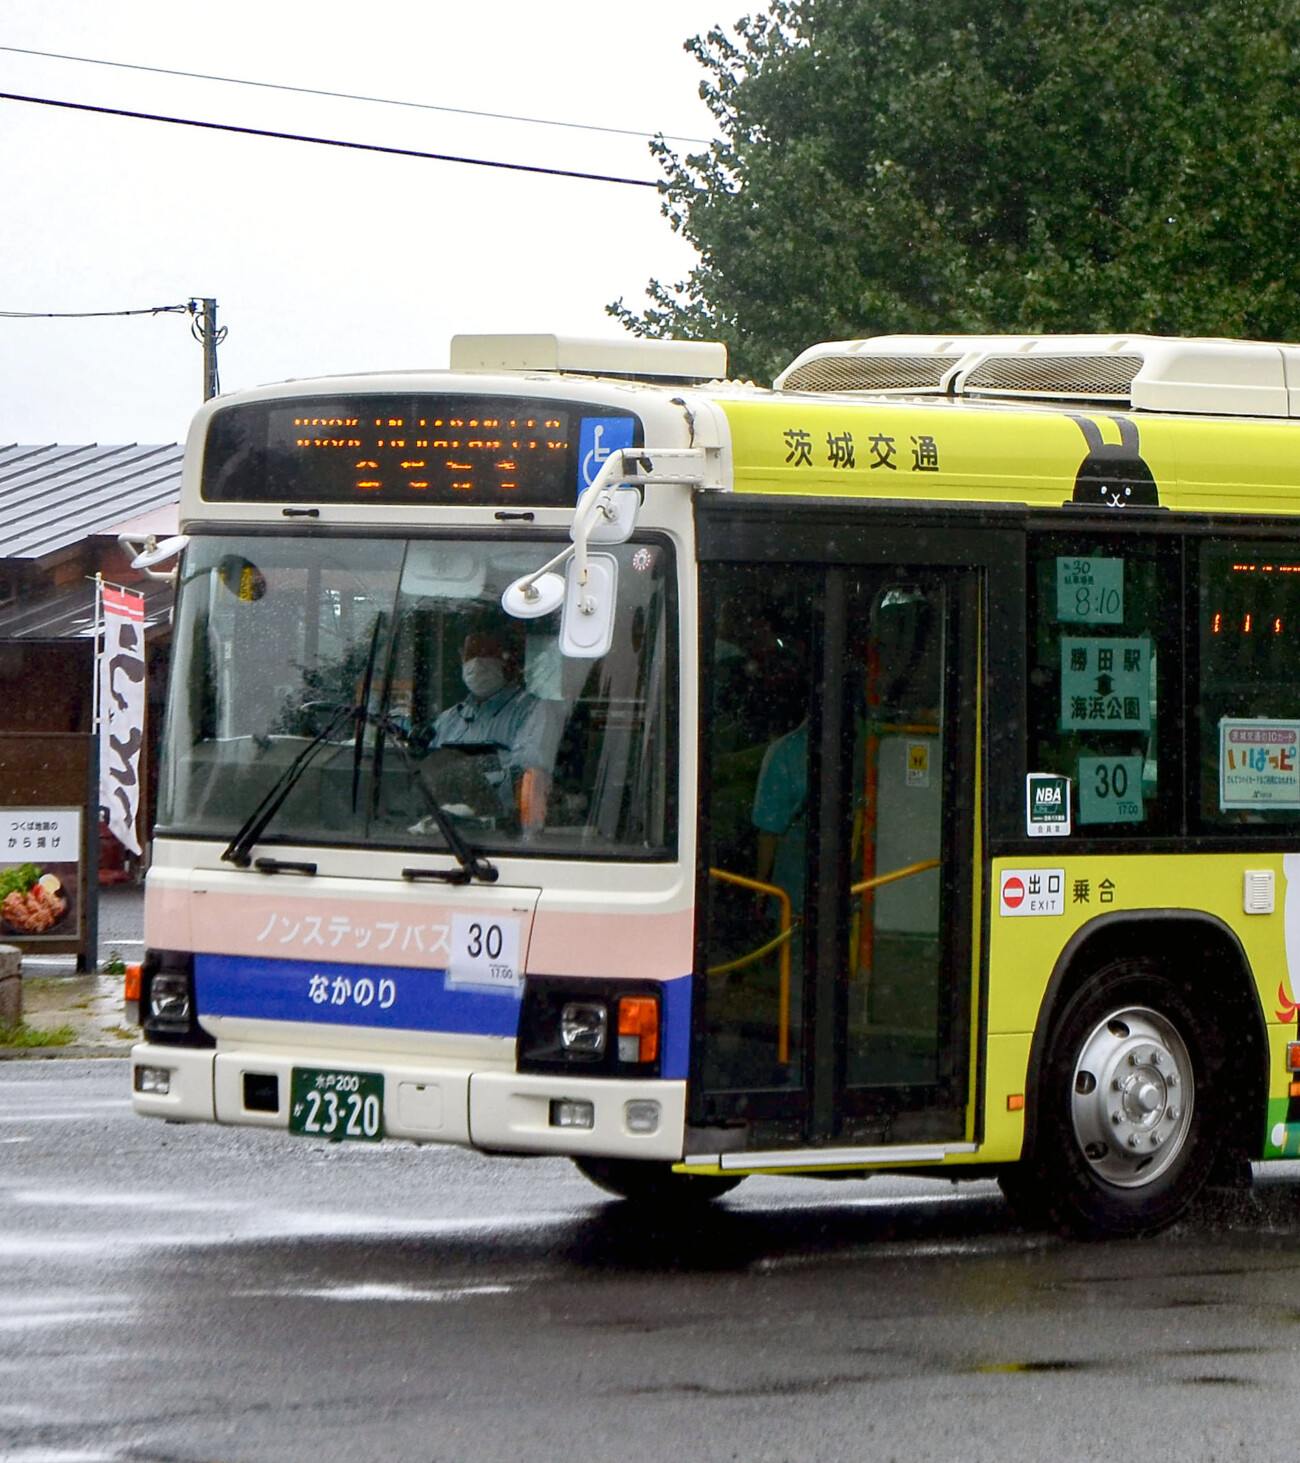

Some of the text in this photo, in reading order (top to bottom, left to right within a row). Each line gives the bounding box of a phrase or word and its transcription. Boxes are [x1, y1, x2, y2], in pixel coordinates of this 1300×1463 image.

[782, 428, 940, 473] 茨城交通
[1072, 560, 1091, 575] 30
[1075, 587, 1120, 616] 8:10
[1070, 647, 1141, 672] 勝田駅
[1071, 695, 1141, 720] 海浜公園
[1094, 763, 1128, 798] 30
[1035, 787, 1062, 802] NBA
[1028, 874, 1060, 895] 出口
[1072, 878, 1116, 904] 乗合
[1030, 900, 1056, 911] EXIT
[256, 912, 450, 953] ノンステップバス
[467, 922, 504, 960] 30
[490, 967, 514, 980] 17:00
[307, 973, 397, 1009] なかのり
[304, 1090, 380, 1137] 23-20
